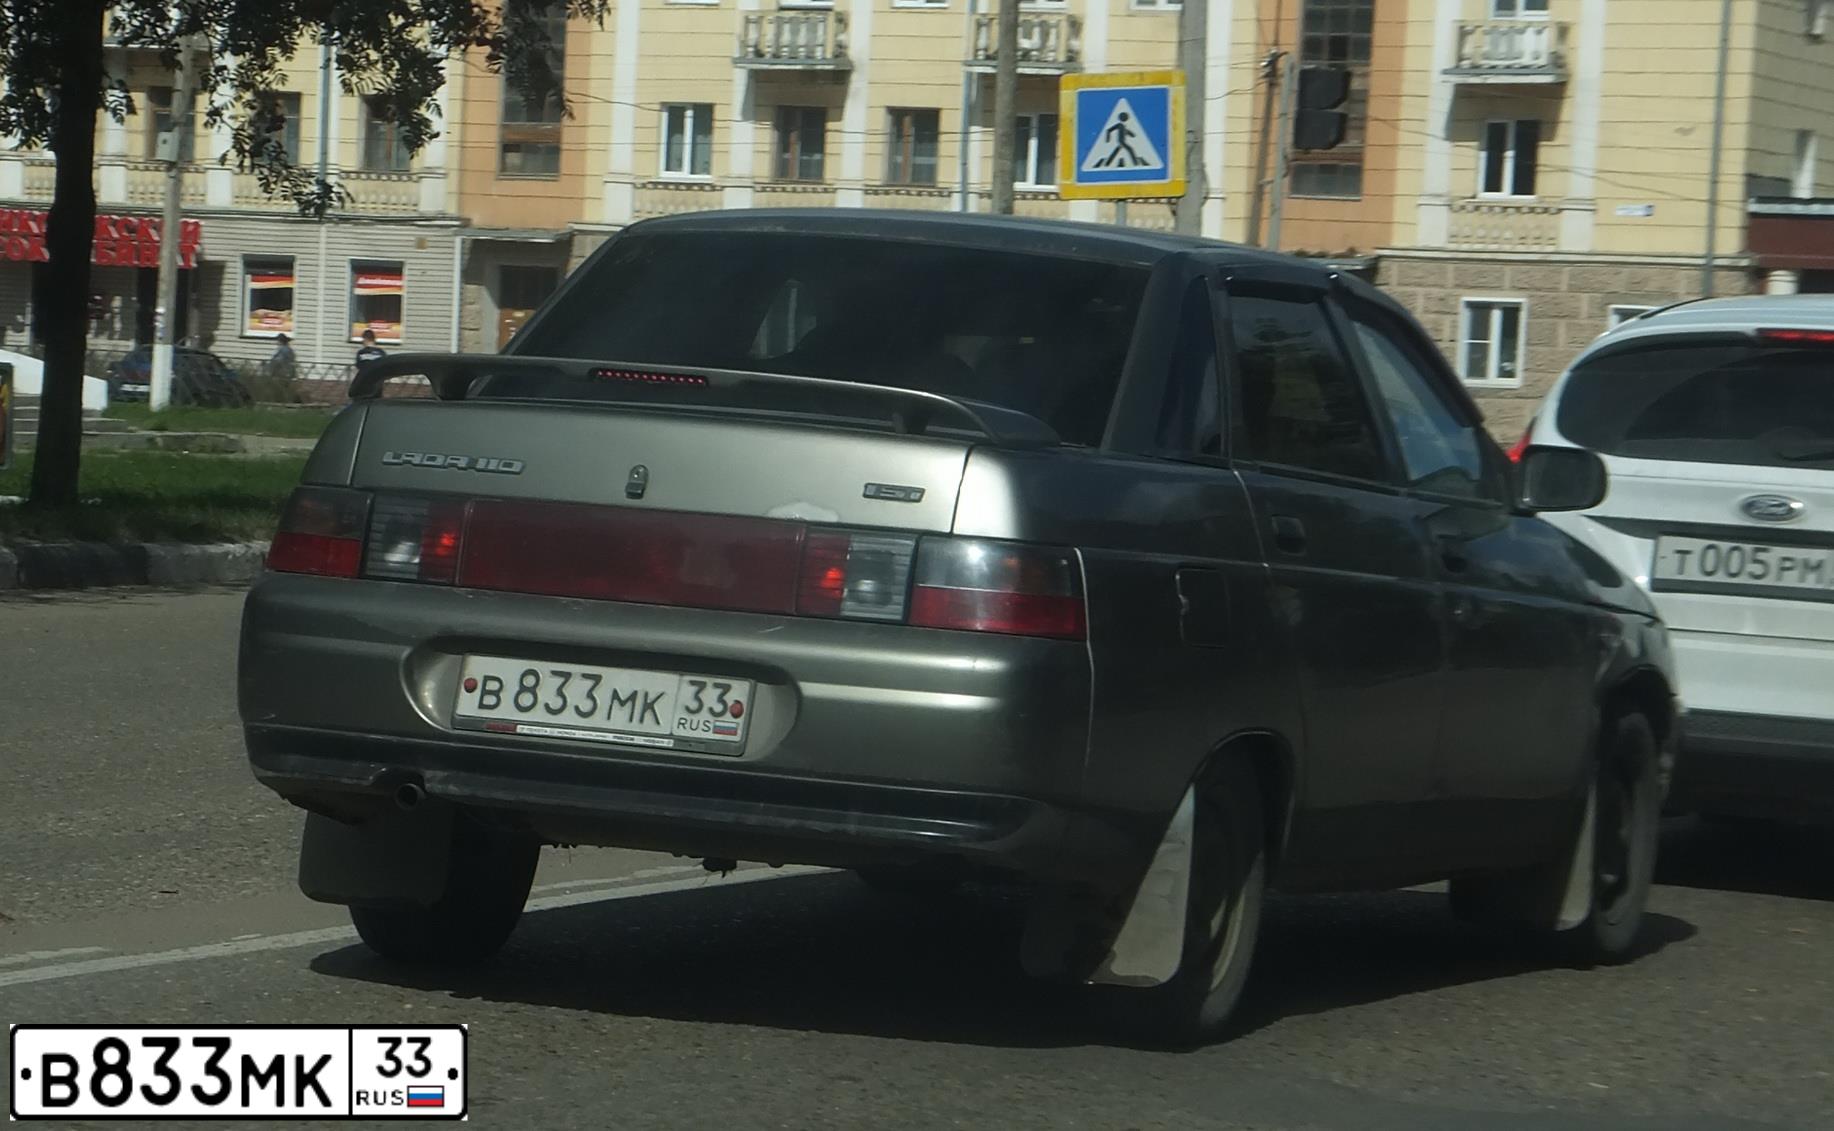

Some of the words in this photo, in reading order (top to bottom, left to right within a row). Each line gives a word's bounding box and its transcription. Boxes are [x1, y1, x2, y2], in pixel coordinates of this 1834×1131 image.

[382, 451, 469, 471] LADA
[474, 457, 526, 475] 110
[684, 680, 732, 718] 33
[677, 716, 711, 732] RUS
